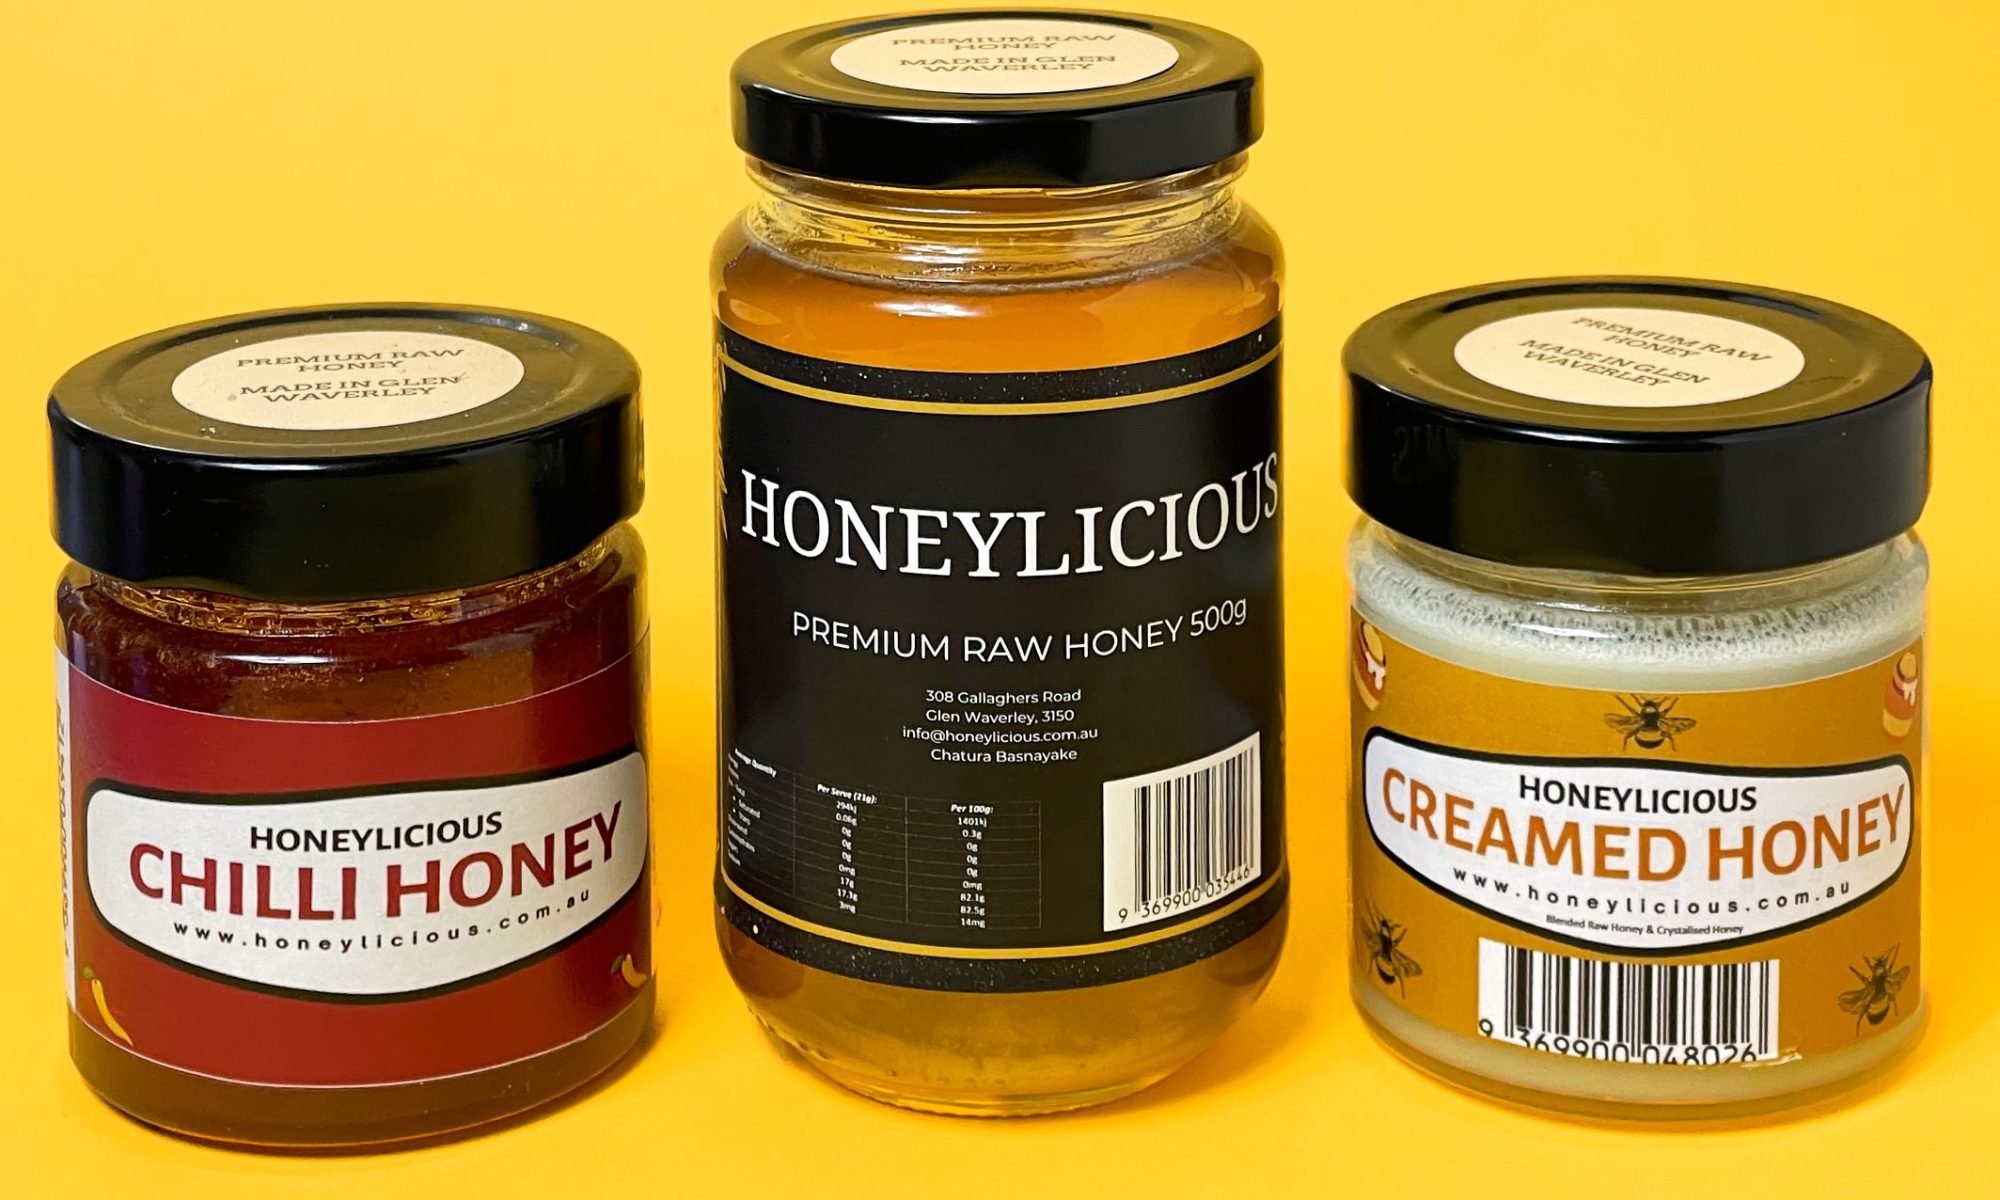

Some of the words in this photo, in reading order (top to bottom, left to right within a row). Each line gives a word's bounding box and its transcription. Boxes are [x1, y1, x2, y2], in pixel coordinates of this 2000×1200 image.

[892, 35, 1035, 46] PREMIUM
[1046, 34, 1116, 42] RAW
[953, 42, 1057, 51] HONEY
[899, 56, 990, 66] MADE
[997, 56, 1027, 64] IN
[1035, 55, 1116, 63] GLEN
[925, 63, 1094, 72] WAVERLEY
[1571, 317, 1700, 348] PREMIUM
[1700, 343, 1772, 362] RAW
[1603, 334, 1702, 358] HONEY
[236, 353, 383, 368] PREMIUM
[392, 349, 464, 359] RAW
[299, 360, 404, 373] HONEY
[1519, 339, 1602, 361] MADE
[1600, 353, 1634, 367] IN
[1633, 362, 1711, 384] GLEN
[1522, 350, 1671, 387] WAVERLEY
[240, 382, 332, 395] MADE
[339, 380, 370, 389] IN
[378, 376, 461, 387] GLEN
[264, 387, 436, 403] WAVERLEY
[740, 451, 1279, 579] HONEYLICIOUS
[792, 611, 950, 662] PREMIUM
[964, 635, 1053, 662] RAW
[1064, 616, 1184, 660] HONEY
[1190, 597, 1247, 638] 500g
[926, 690, 954, 703] 308
[957, 691, 1039, 707] Gallaghers
[1042, 689, 1081, 703] Road
[925, 709, 960, 723] Glen
[965, 711, 1038, 726] Waverley,
[1041, 709, 1075, 723] 3150
[902, 726, 1098, 746] info@honeylicious.com.au
[930, 748, 992, 763] Chatura
[996, 748, 1078, 764] Basnayake
[817, 784, 830, 793] Per
[831, 787, 852, 800] Serve
[1519, 774, 1758, 815] HONEYLICIOUS
[951, 804, 967, 814] Per
[968, 805, 994, 815] 100g:
[835, 812, 857, 826] 0.06g
[1382, 767, 1687, 883] CREAMED
[1708, 783, 1906, 882] HONEY
[250, 811, 502, 853] HONEYLICIOUS
[841, 827, 852, 838] 0g
[962, 829, 982, 840] 0.3g
[841, 839, 852, 850] 0g
[966, 842, 978, 852] 0g
[128, 842, 357, 922] CHILLI
[384, 800, 622, 918] HONEY
[841, 852, 852, 863] 0g
[966, 855, 978, 865] 0g
[838, 864, 856, 876] 0mg
[966, 868, 978, 878] 0g
[840, 876, 854, 889] 17g
[962, 880, 982, 891] 0mg
[1453, 866, 1851, 915] www.honeylicious.com.au
[1118, 908, 1128, 924] 9
[1141, 887, 1201, 918] 369900
[1206, 866, 1250, 898] 035446
[839, 901, 856, 914] 3mg
[173, 888, 590, 952] www.honeylicious.com.au
[1546, 915, 1585, 928] Blended
[1588, 921, 1608, 931] Raw
[1611, 923, 1643, 935] Honey
[1646, 925, 1654, 934] &
[1713, 925, 1743, 934] Honey
[1478, 1018, 1493, 1037] 9
